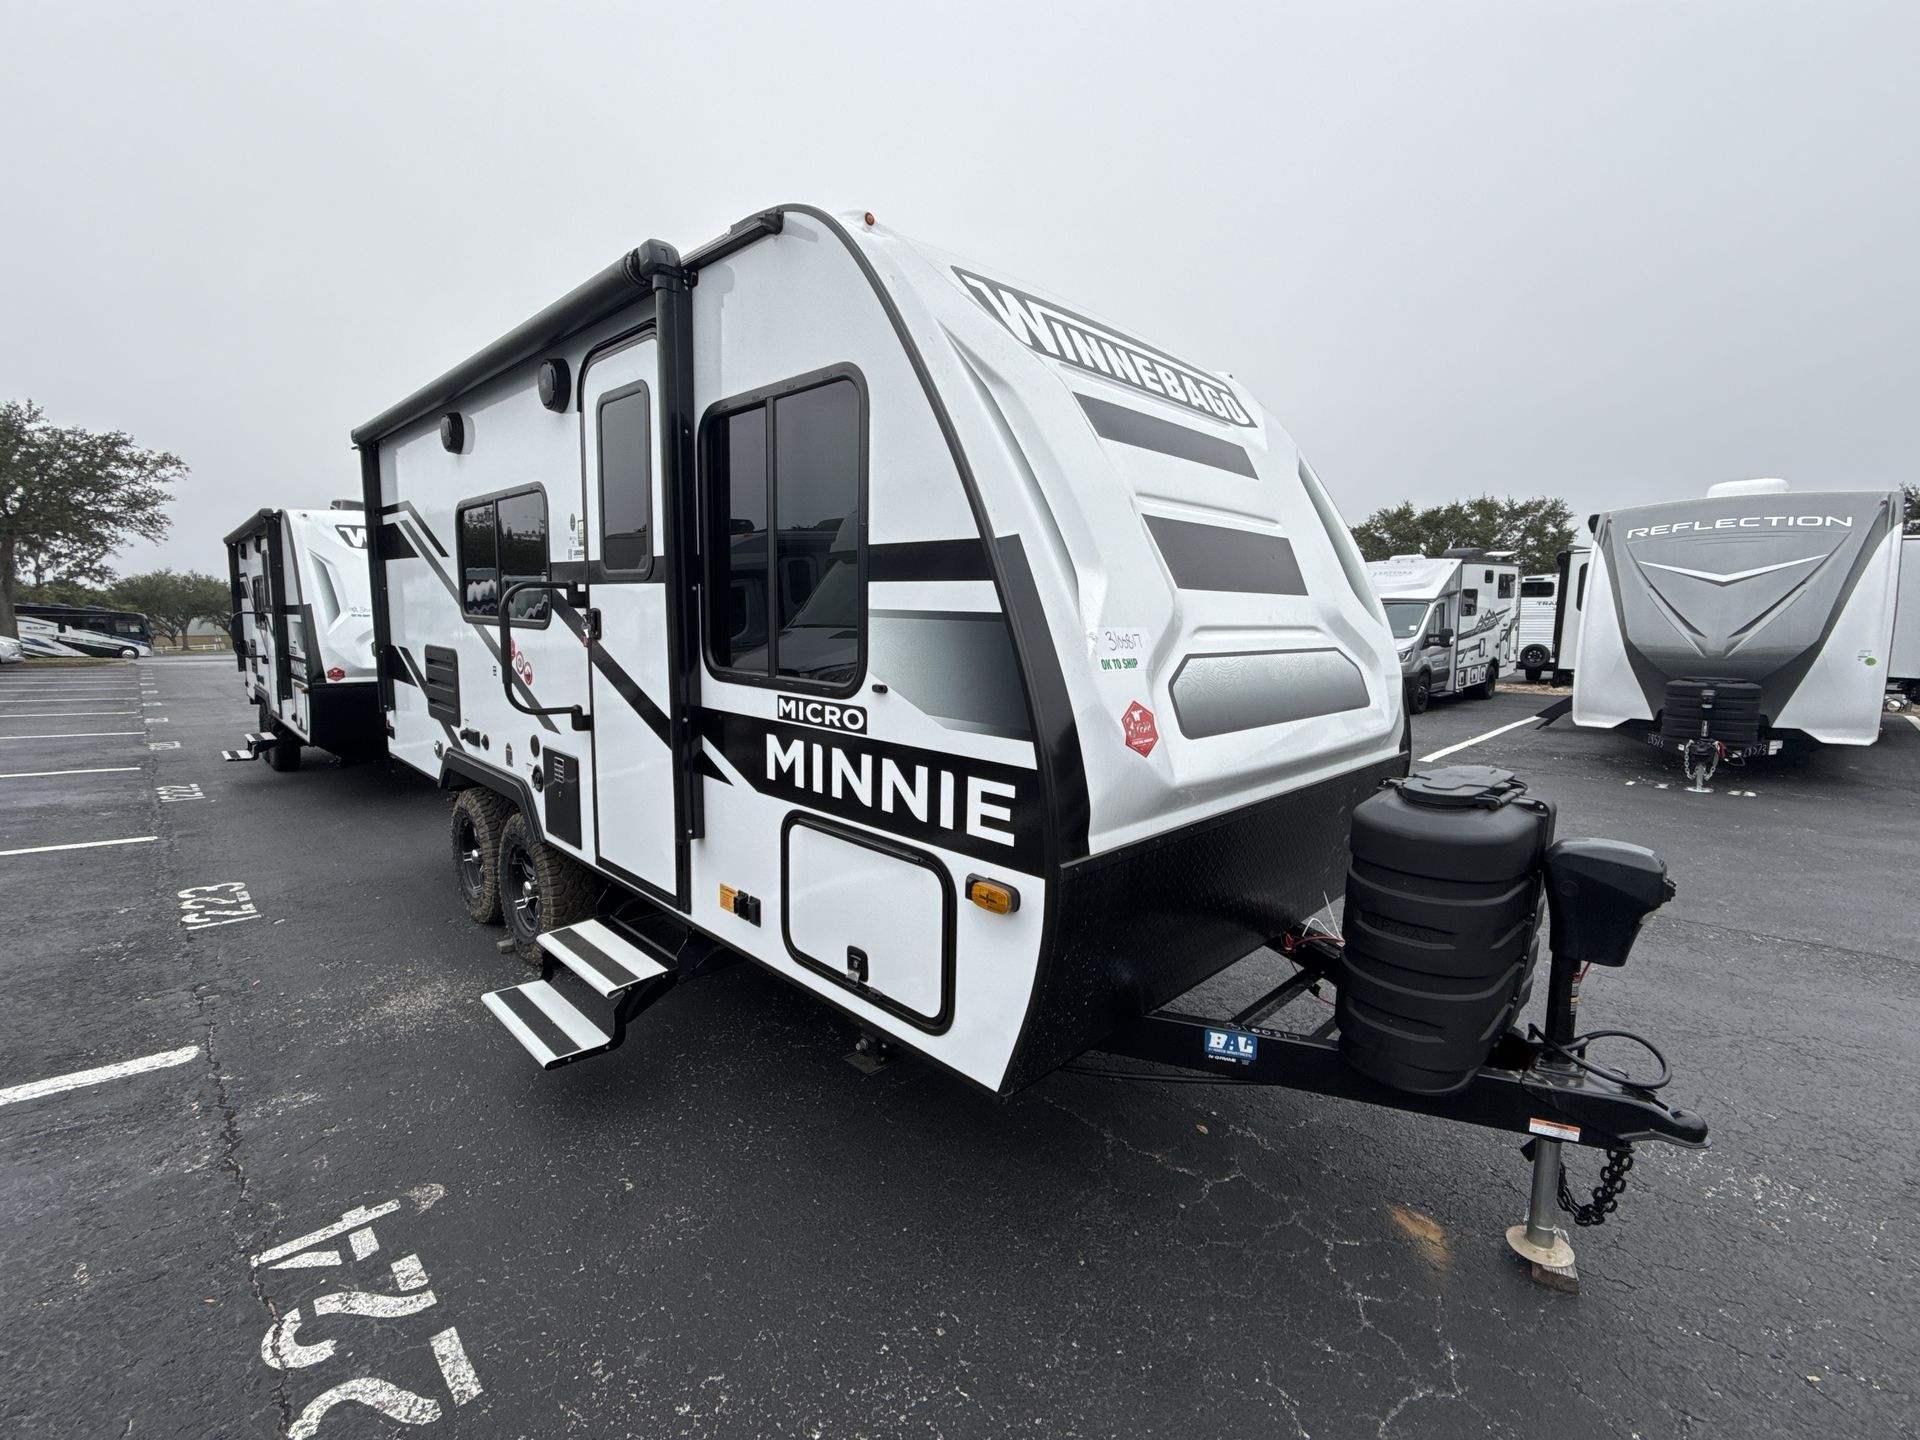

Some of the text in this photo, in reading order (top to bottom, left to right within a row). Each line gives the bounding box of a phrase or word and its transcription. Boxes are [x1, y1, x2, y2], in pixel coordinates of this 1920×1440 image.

[961, 273, 1250, 425] WINNEBAGO
[1626, 516, 1853, 539] REFLECTION
[1100, 657, 1138, 670] OK TO SHIP
[778, 697, 865, 731] MICRO
[766, 734, 1016, 847] MINNIE
[1208, 1031, 1254, 1054] BAL
